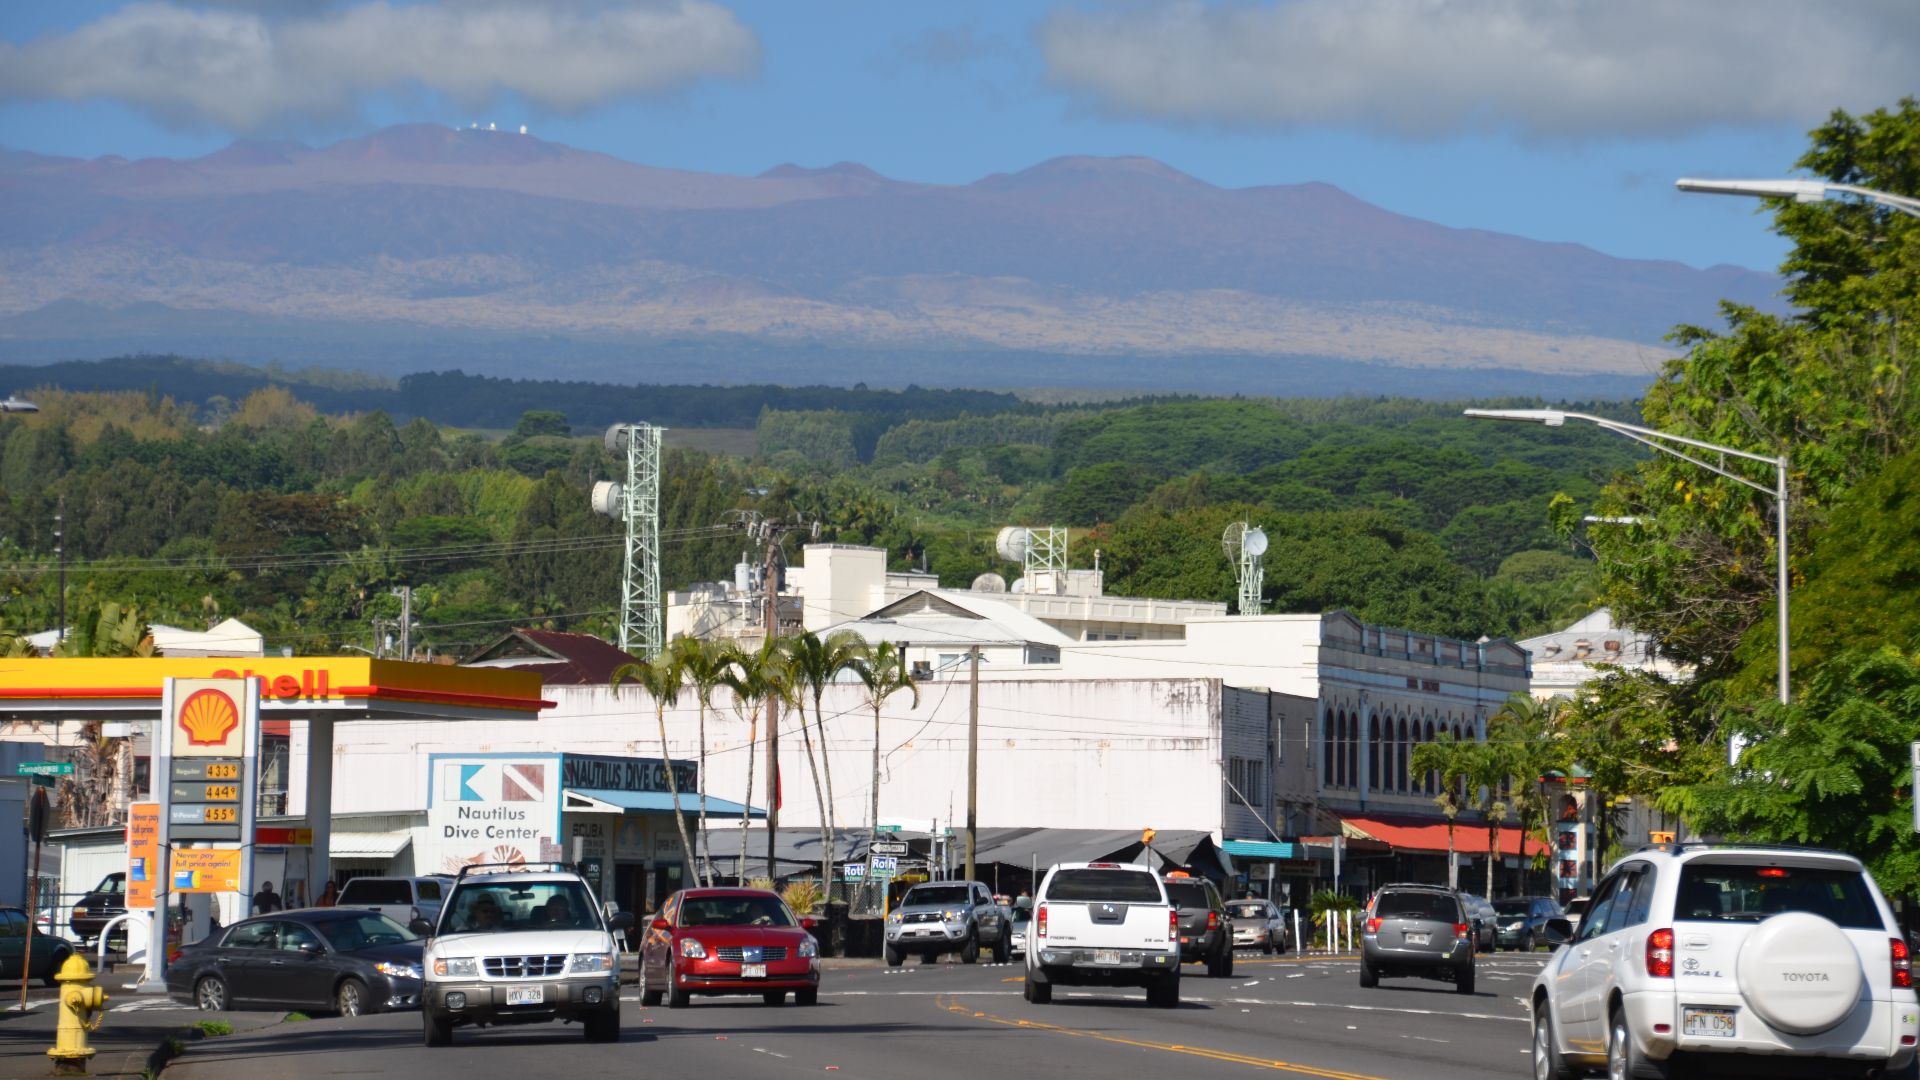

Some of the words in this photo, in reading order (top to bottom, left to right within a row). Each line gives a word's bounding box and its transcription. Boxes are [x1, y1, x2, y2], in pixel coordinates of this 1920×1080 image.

[570, 760, 621, 788] NAUTILUS
[626, 762, 650, 790] DIVE
[458, 806, 525, 820] Nautilus
[444, 825, 480, 839] Dive
[486, 825, 540, 839] Center
[573, 823, 603, 837] SCUBA
[1782, 972, 1830, 982] TOYOTA
[1685, 1014, 1706, 1029] HFN
[1713, 1015, 1734, 1030] 058
